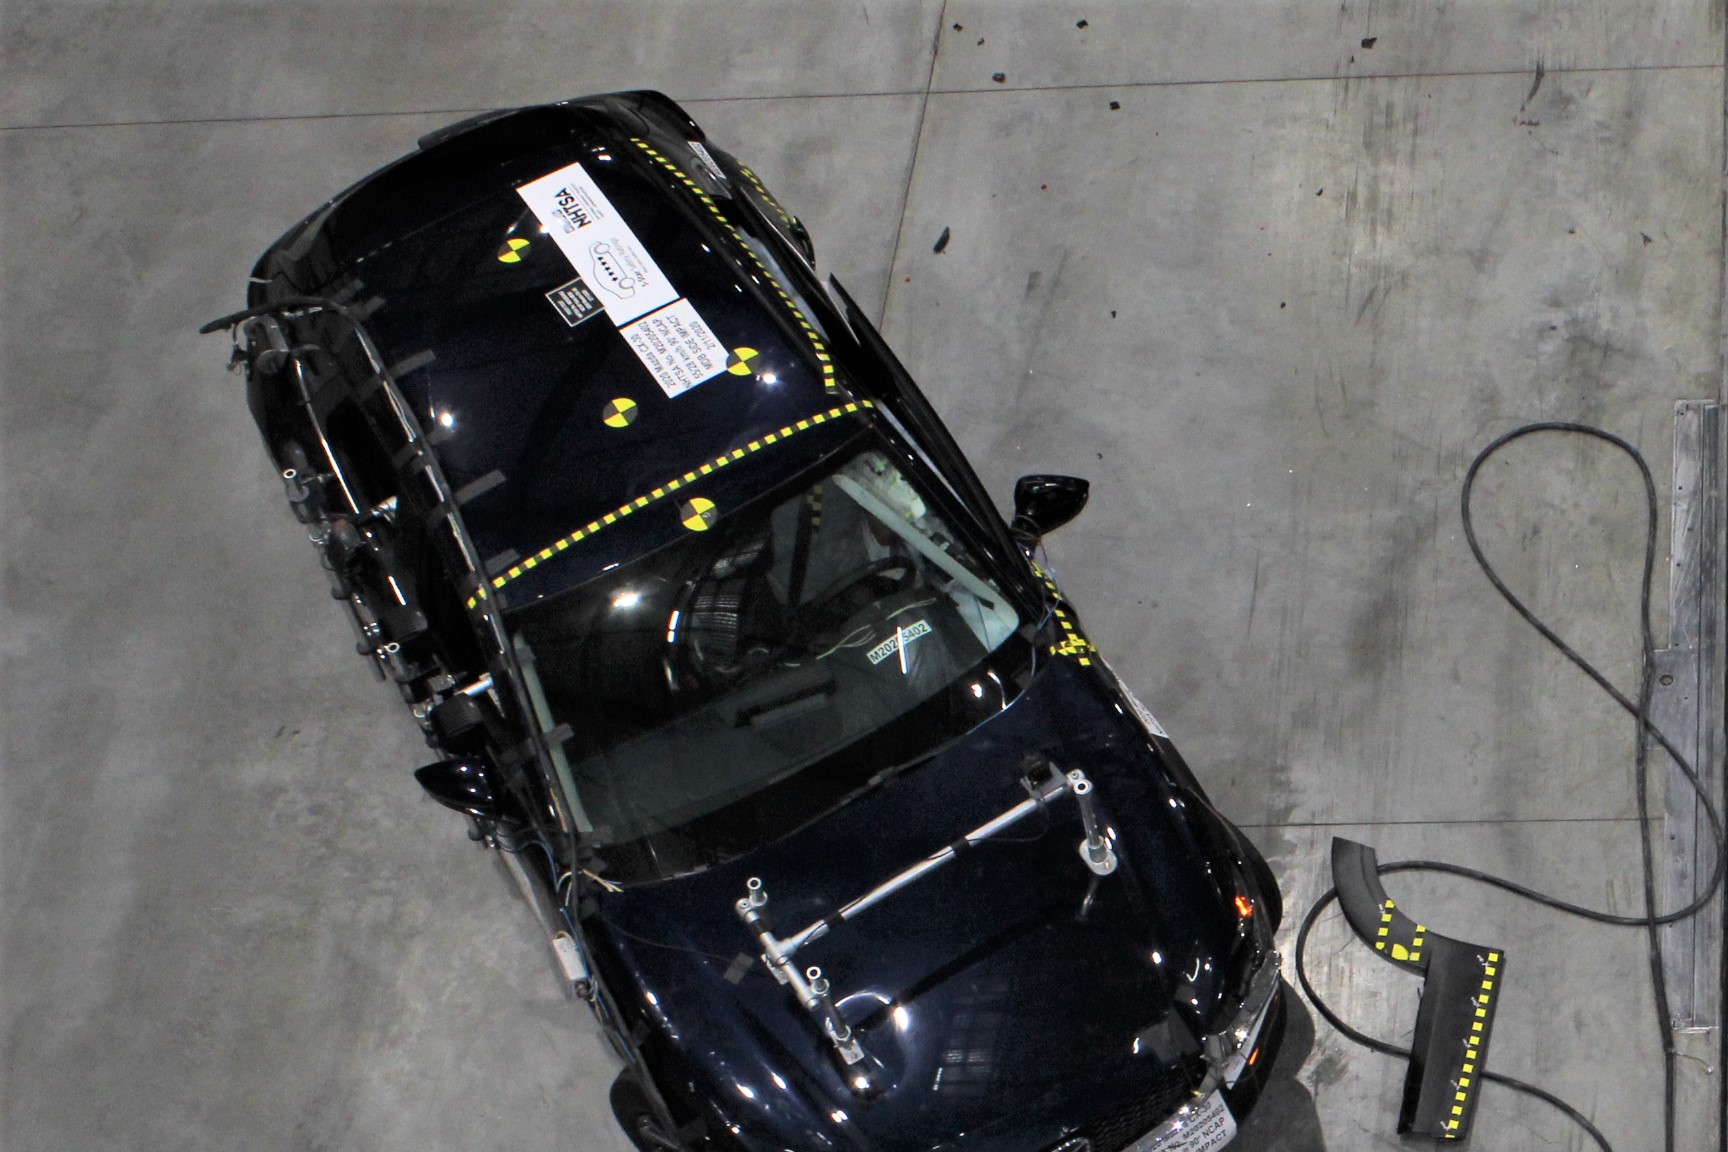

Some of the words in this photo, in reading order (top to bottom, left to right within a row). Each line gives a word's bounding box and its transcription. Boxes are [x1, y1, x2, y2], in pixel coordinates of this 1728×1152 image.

[554, 187, 592, 230] NHTSA
[652, 319, 670, 336] NCAP
[666, 315, 689, 338] IMPACT
[690, 321, 716, 350] 2/11/2020
[631, 334, 649, 352] CX-30
[638, 321, 667, 354] M20205402
[685, 337, 702, 354] SIDE
[646, 352, 664, 372] Mazda
[664, 354, 675, 366] No.
[674, 346, 690, 361] km/h
[697, 353, 713, 370] MDB
[659, 371, 676, 388] 2020
[672, 365, 692, 388] NHTSA
[685, 361, 703, 379] 55/28
[869, 622, 928, 663] M2025402
[1183, 1104, 1225, 1139] M20205402
[1203, 1117, 1225, 1138] NCAP
